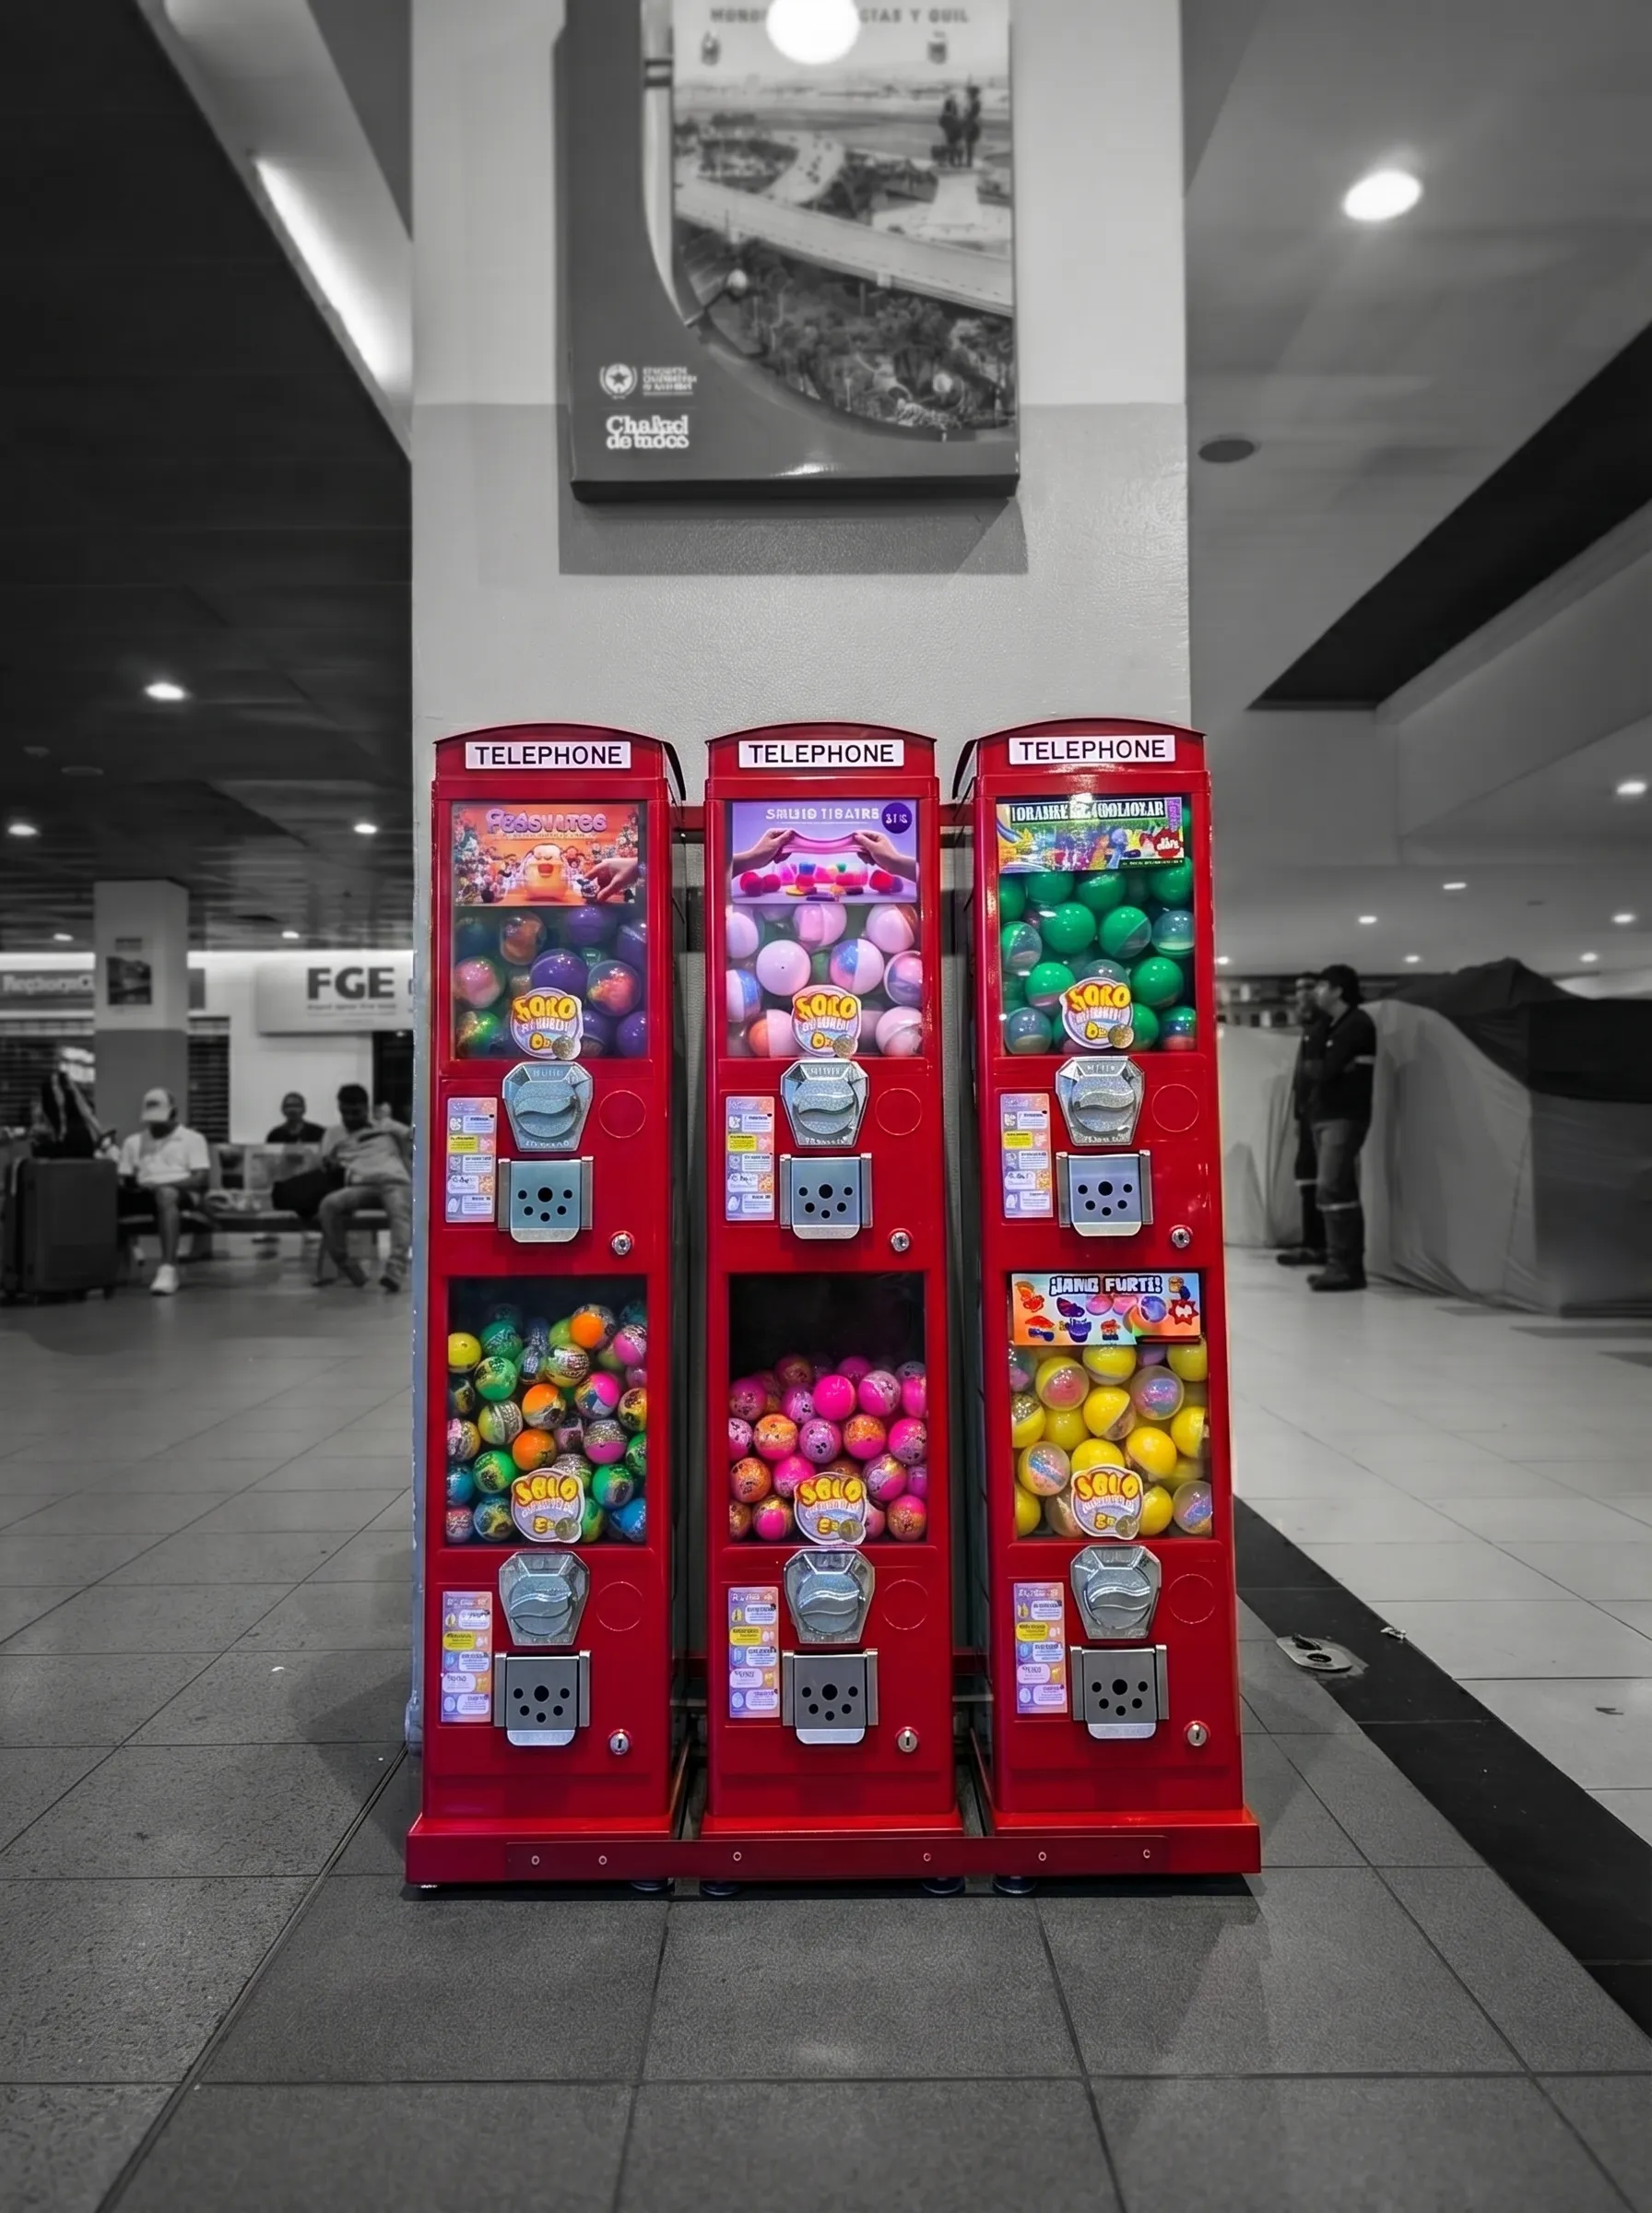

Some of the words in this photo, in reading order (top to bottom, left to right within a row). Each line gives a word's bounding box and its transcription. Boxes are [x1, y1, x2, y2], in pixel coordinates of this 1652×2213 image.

[475, 746, 622, 765] TELEPHONE
[749, 744, 894, 763] TELEPHONE
[1020, 740, 1166, 761] TELEPHONE
[307, 966, 395, 1000] FGE
